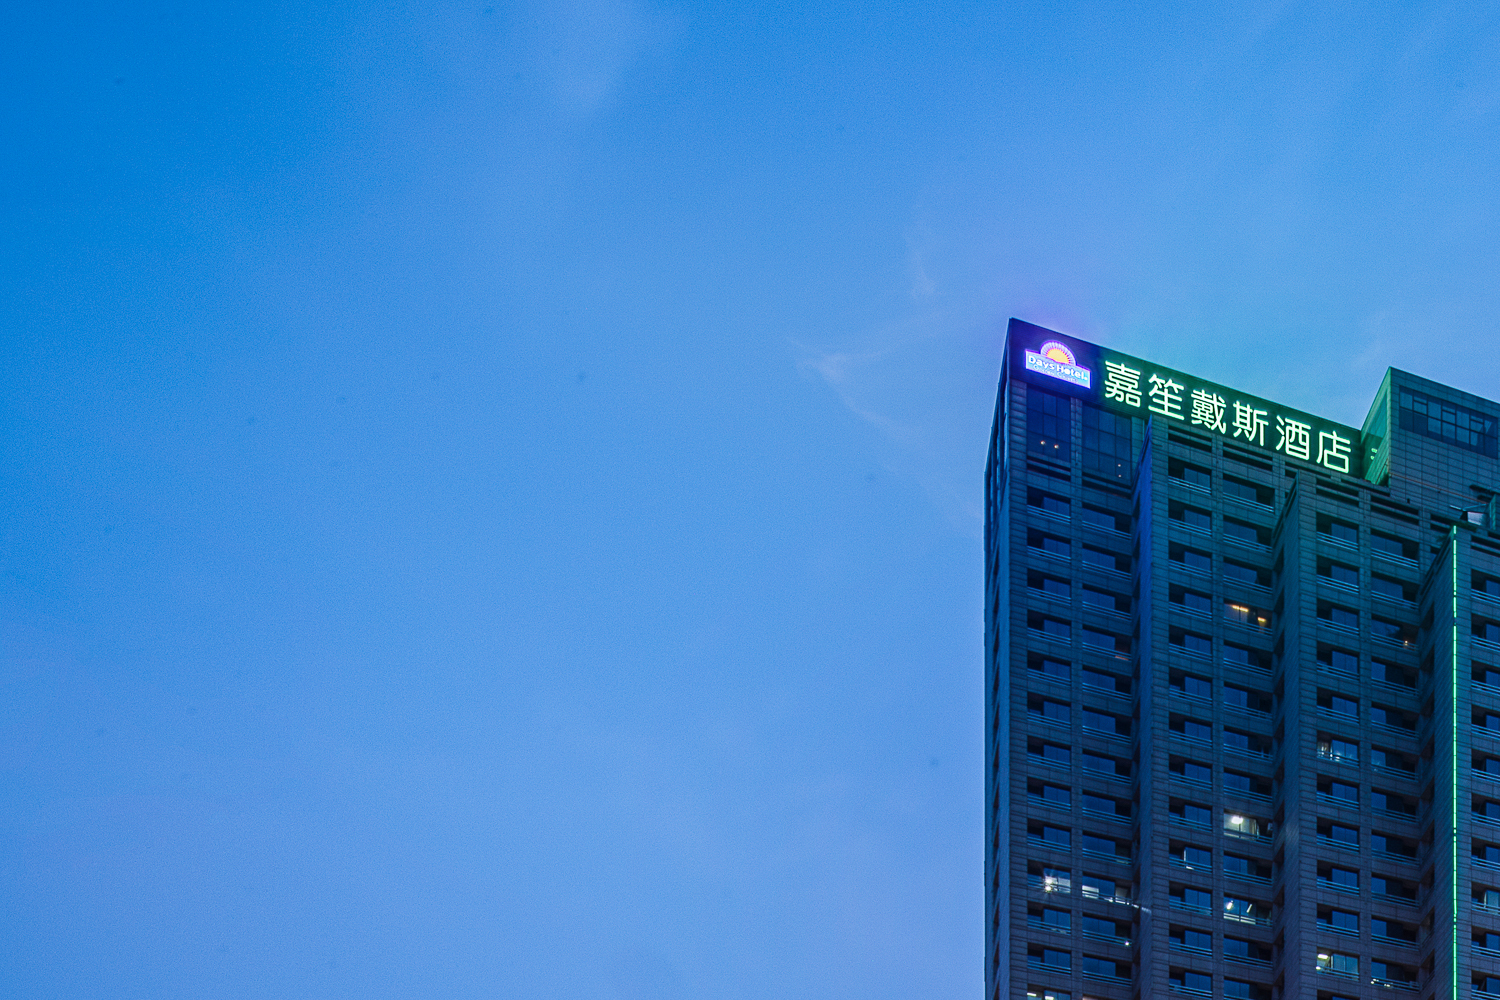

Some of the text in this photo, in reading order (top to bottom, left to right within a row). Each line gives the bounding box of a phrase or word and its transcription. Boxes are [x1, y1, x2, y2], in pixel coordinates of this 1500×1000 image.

[1028, 355, 1055, 369] Days
[1056, 364, 1084, 380] Hotel
[1105, 360, 1352, 474] 嘉笙戴斯酒店
